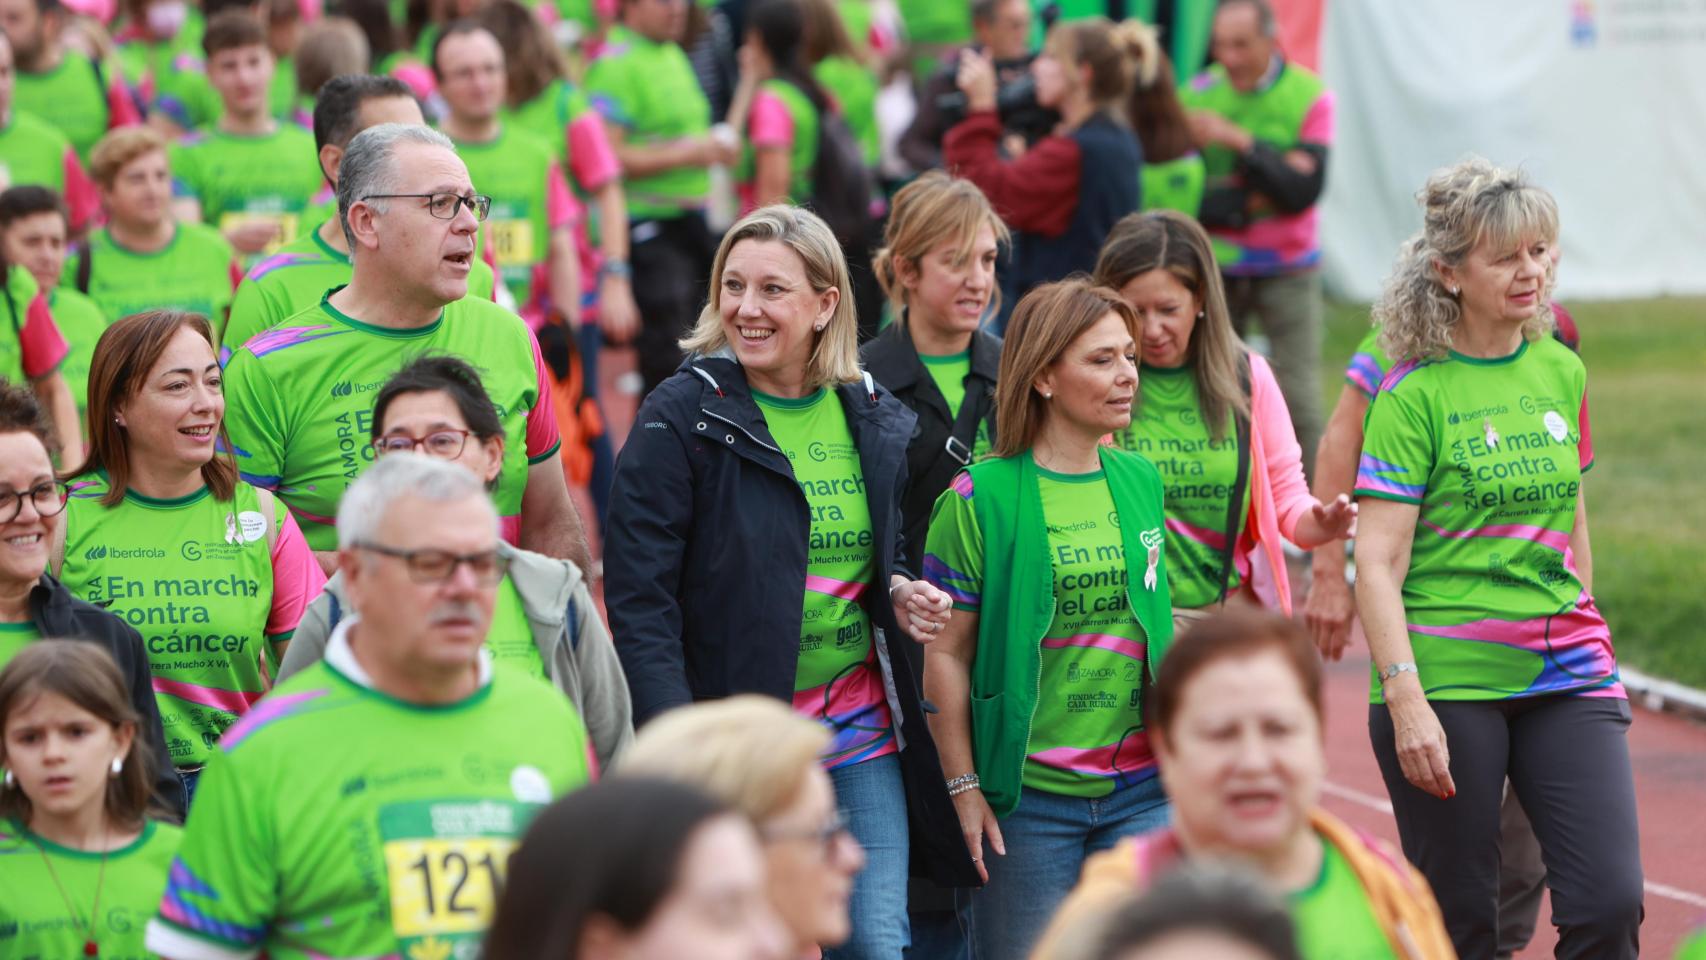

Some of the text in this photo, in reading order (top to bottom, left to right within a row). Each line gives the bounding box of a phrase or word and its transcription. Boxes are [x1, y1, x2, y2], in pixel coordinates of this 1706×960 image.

[355, 381, 384, 394] Iber
[355, 410, 372, 433] E
[1462, 404, 1509, 423] Iberdrola
[1124, 432, 1153, 452] En
[1156, 456, 1205, 477] ntra
[1451, 439, 1480, 512] ZAMORA
[1476, 455, 1558, 482] contra
[1481, 479, 1580, 509] el cánce
[809, 504, 845, 522] tra
[810, 526, 873, 549] ánce
[109, 544, 166, 560] Iberdrola
[814, 555, 842, 565] Mucho
[844, 554, 850, 562] X
[1056, 545, 1090, 565] En
[107, 575, 145, 599] En
[154, 573, 258, 599] marcha
[1061, 565, 1128, 591] contr
[1061, 592, 1088, 617] el
[148, 628, 249, 655] cáncer
[151, 662, 172, 670] rera
[173, 659, 206, 670] Mucho
[207, 658, 214, 668] X
